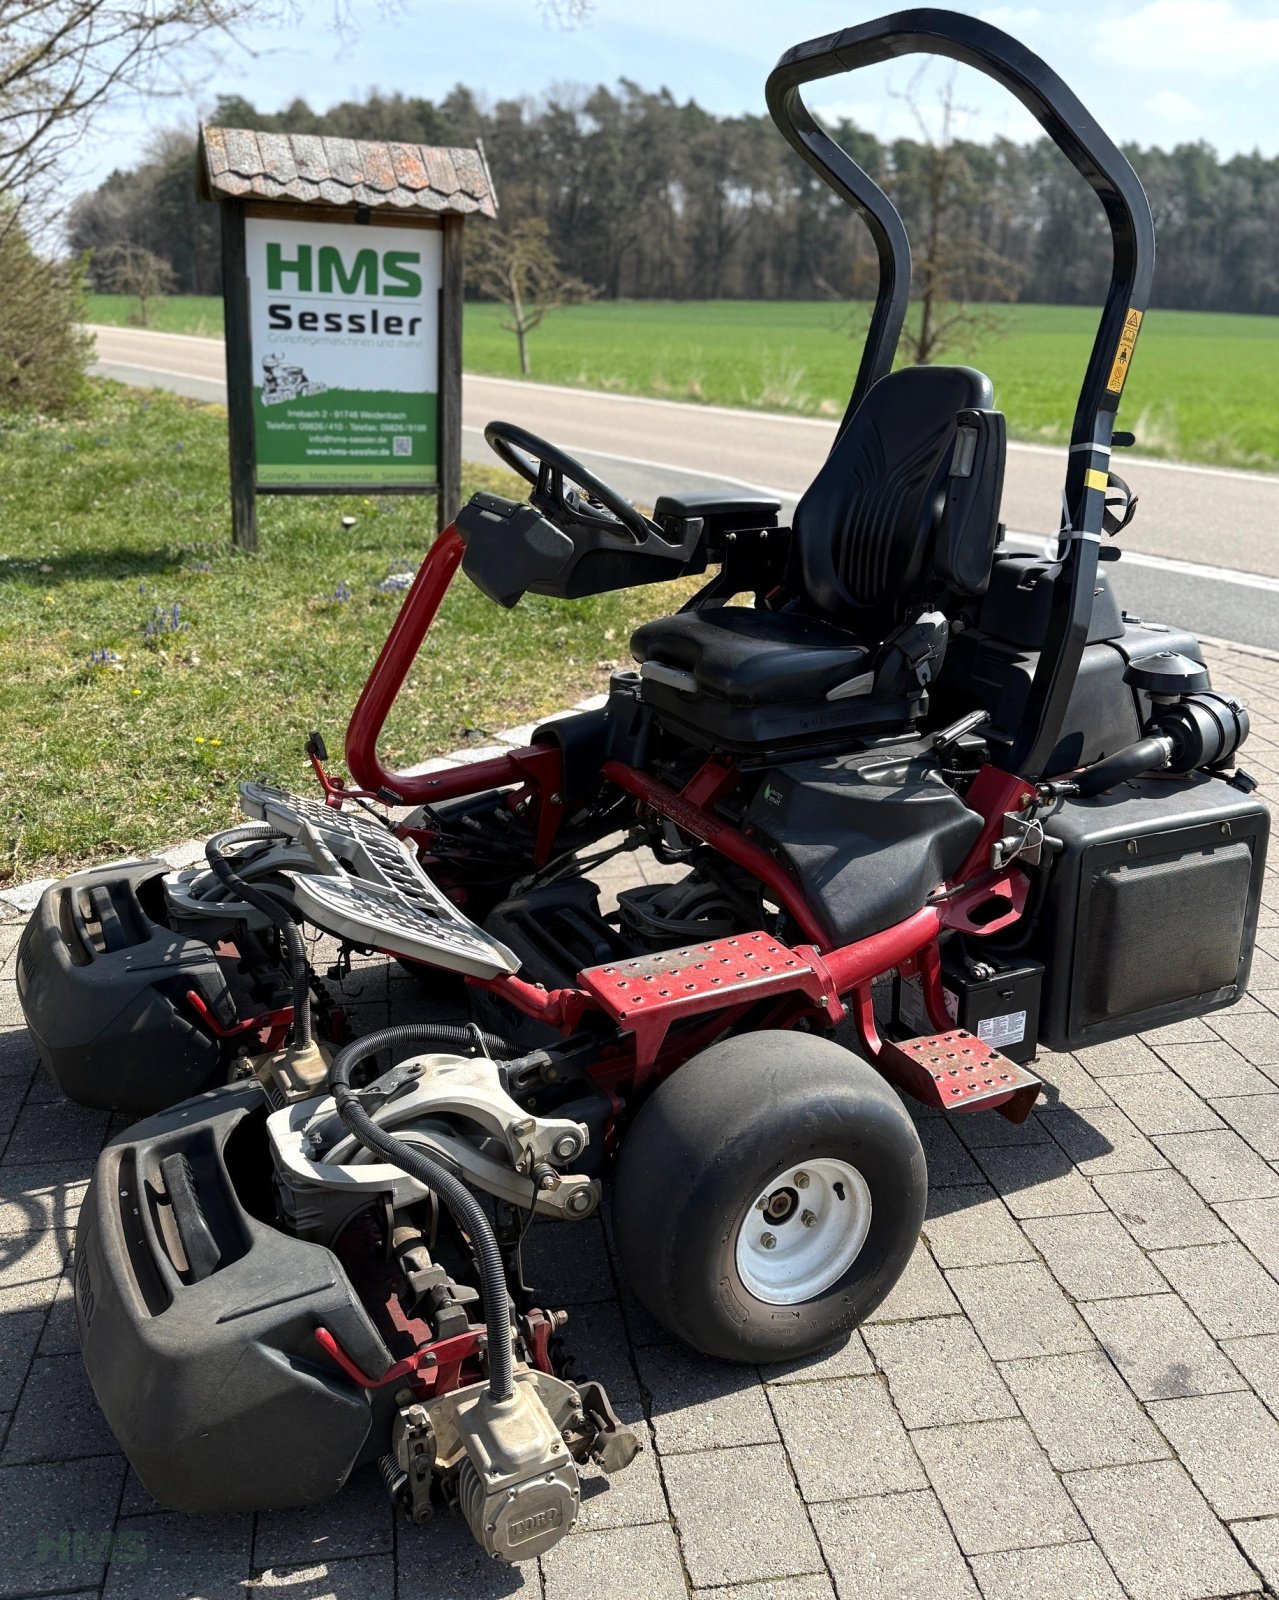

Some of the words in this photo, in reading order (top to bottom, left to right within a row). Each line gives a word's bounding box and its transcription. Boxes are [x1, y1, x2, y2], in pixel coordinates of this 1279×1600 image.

[266, 242, 422, 298] HMS
[268, 304, 422, 336] Sessler
[305, 448, 391, 457] www.hms-sessler.de
